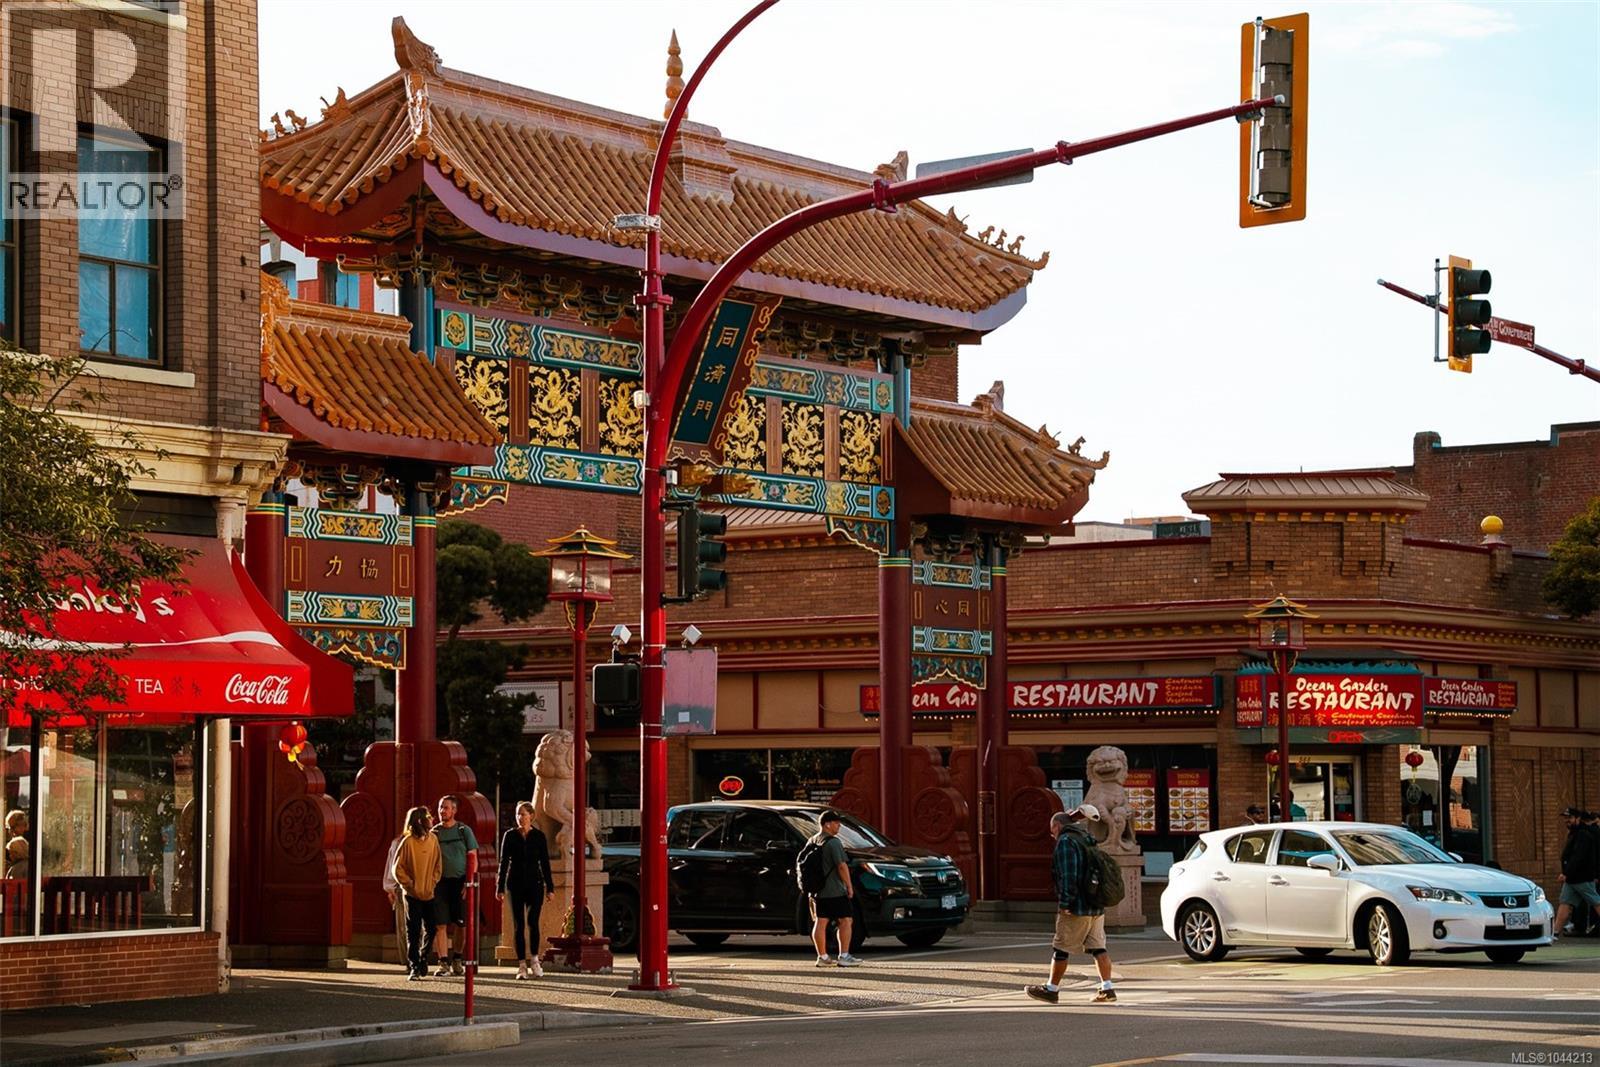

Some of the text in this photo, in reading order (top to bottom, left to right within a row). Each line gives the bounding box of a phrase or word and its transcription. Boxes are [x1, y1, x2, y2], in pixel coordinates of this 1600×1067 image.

[135, 678, 164, 694] TEA
[225, 673, 292, 705] Coca-Cola
[1296, 677, 1389, 692] Ocean Garden
[1441, 680, 1484, 692] Ocean Garden
[911, 684, 978, 707] ean Gar
[1013, 681, 1159, 707] RESTAURANT
[1269, 691, 1415, 711] RESTAURANT
[1429, 690, 1496, 707] RESTAURANT
